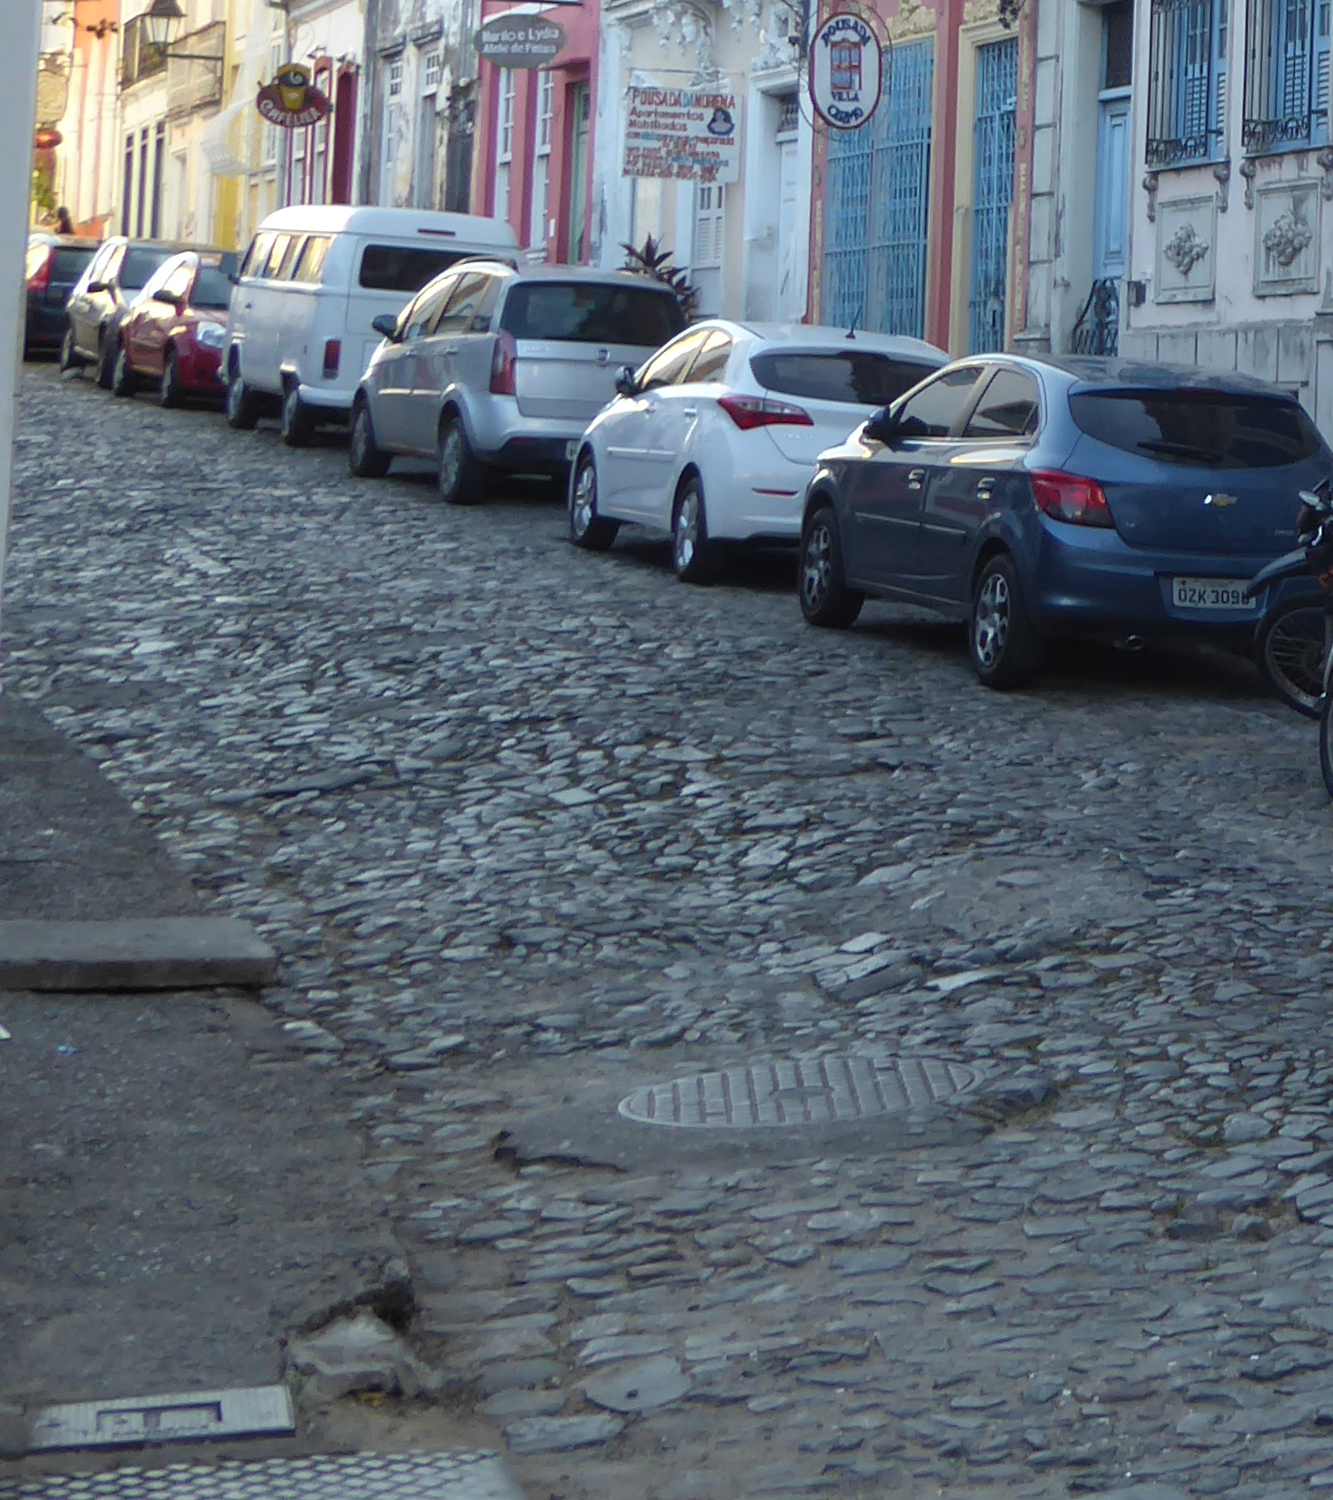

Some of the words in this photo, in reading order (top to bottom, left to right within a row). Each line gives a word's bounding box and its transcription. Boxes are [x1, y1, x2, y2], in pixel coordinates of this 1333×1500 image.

[821, 18, 871, 48] POUSADA
[632, 89, 682, 106] POUSADA
[831, 90, 860, 102] VILLA
